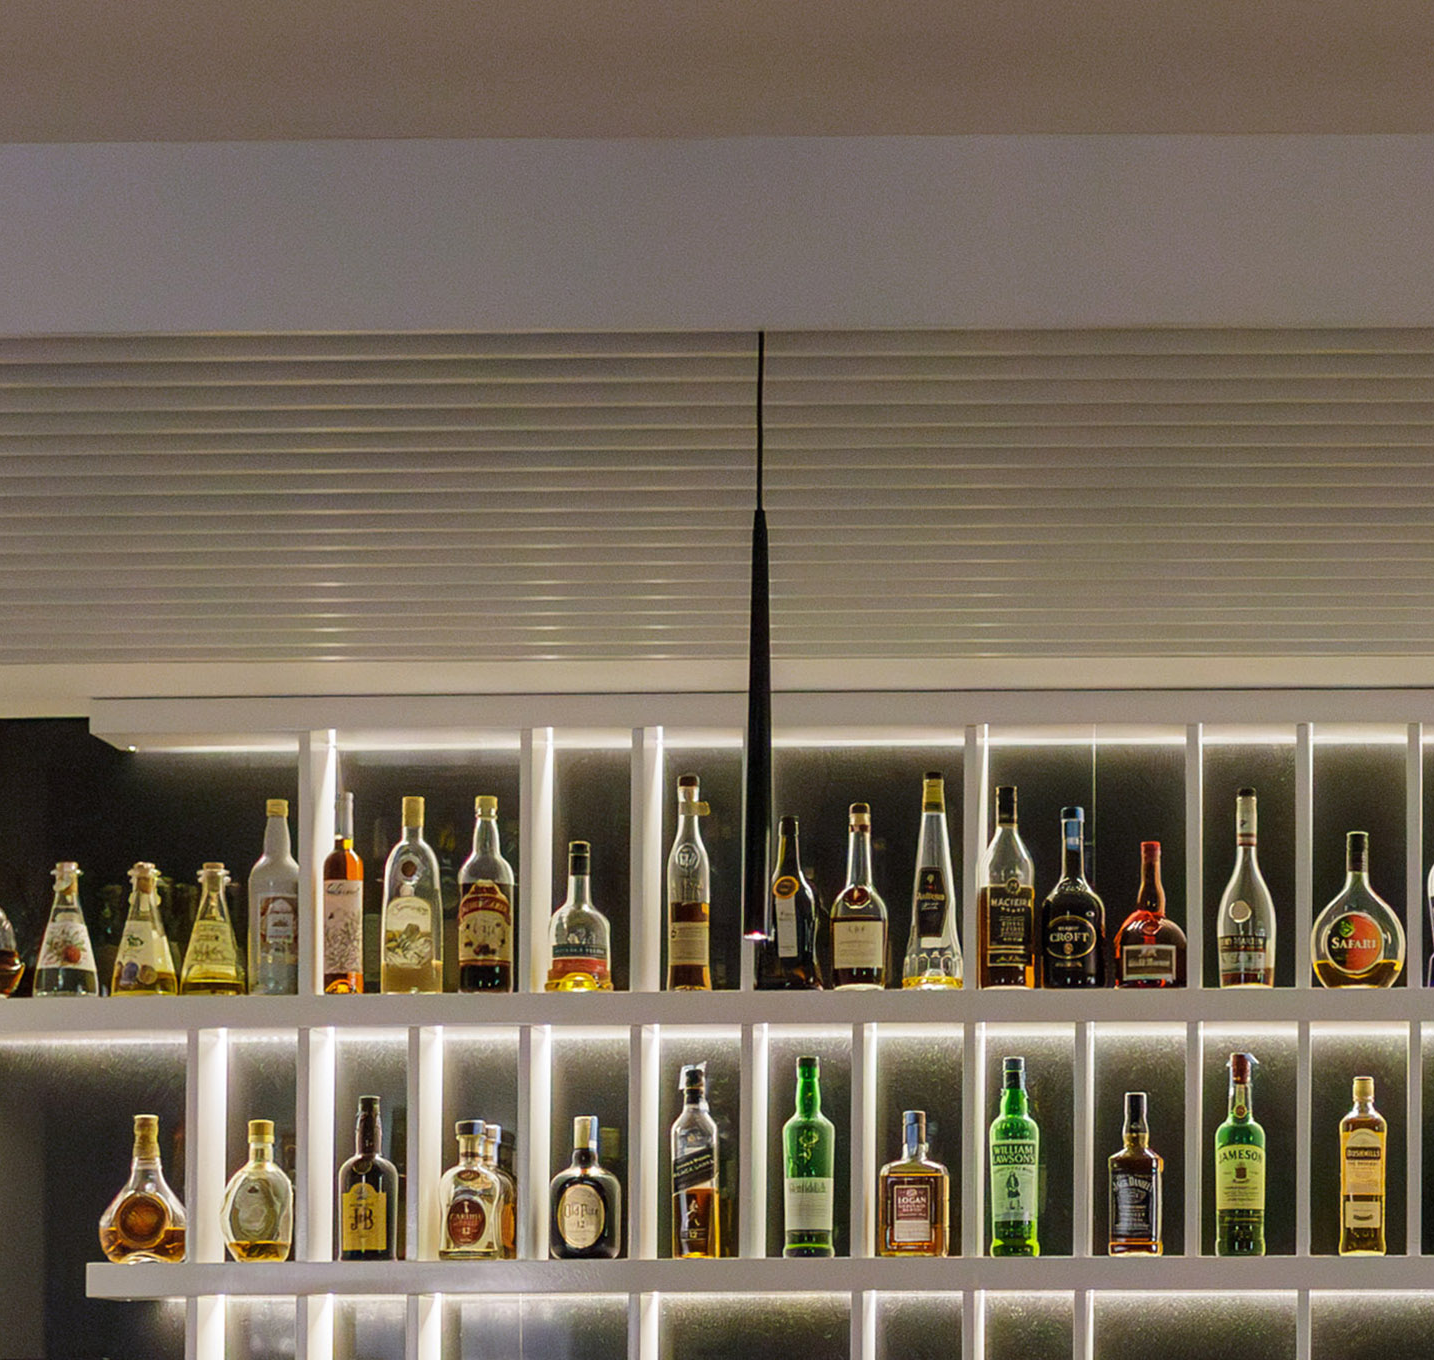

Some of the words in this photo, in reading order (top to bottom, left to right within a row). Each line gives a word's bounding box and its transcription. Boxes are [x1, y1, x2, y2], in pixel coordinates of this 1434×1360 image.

[1049, 932, 1090, 943] CROFT
[1331, 937, 1378, 949] SAFARI
[993, 1145, 1034, 1155] WILLIAM
